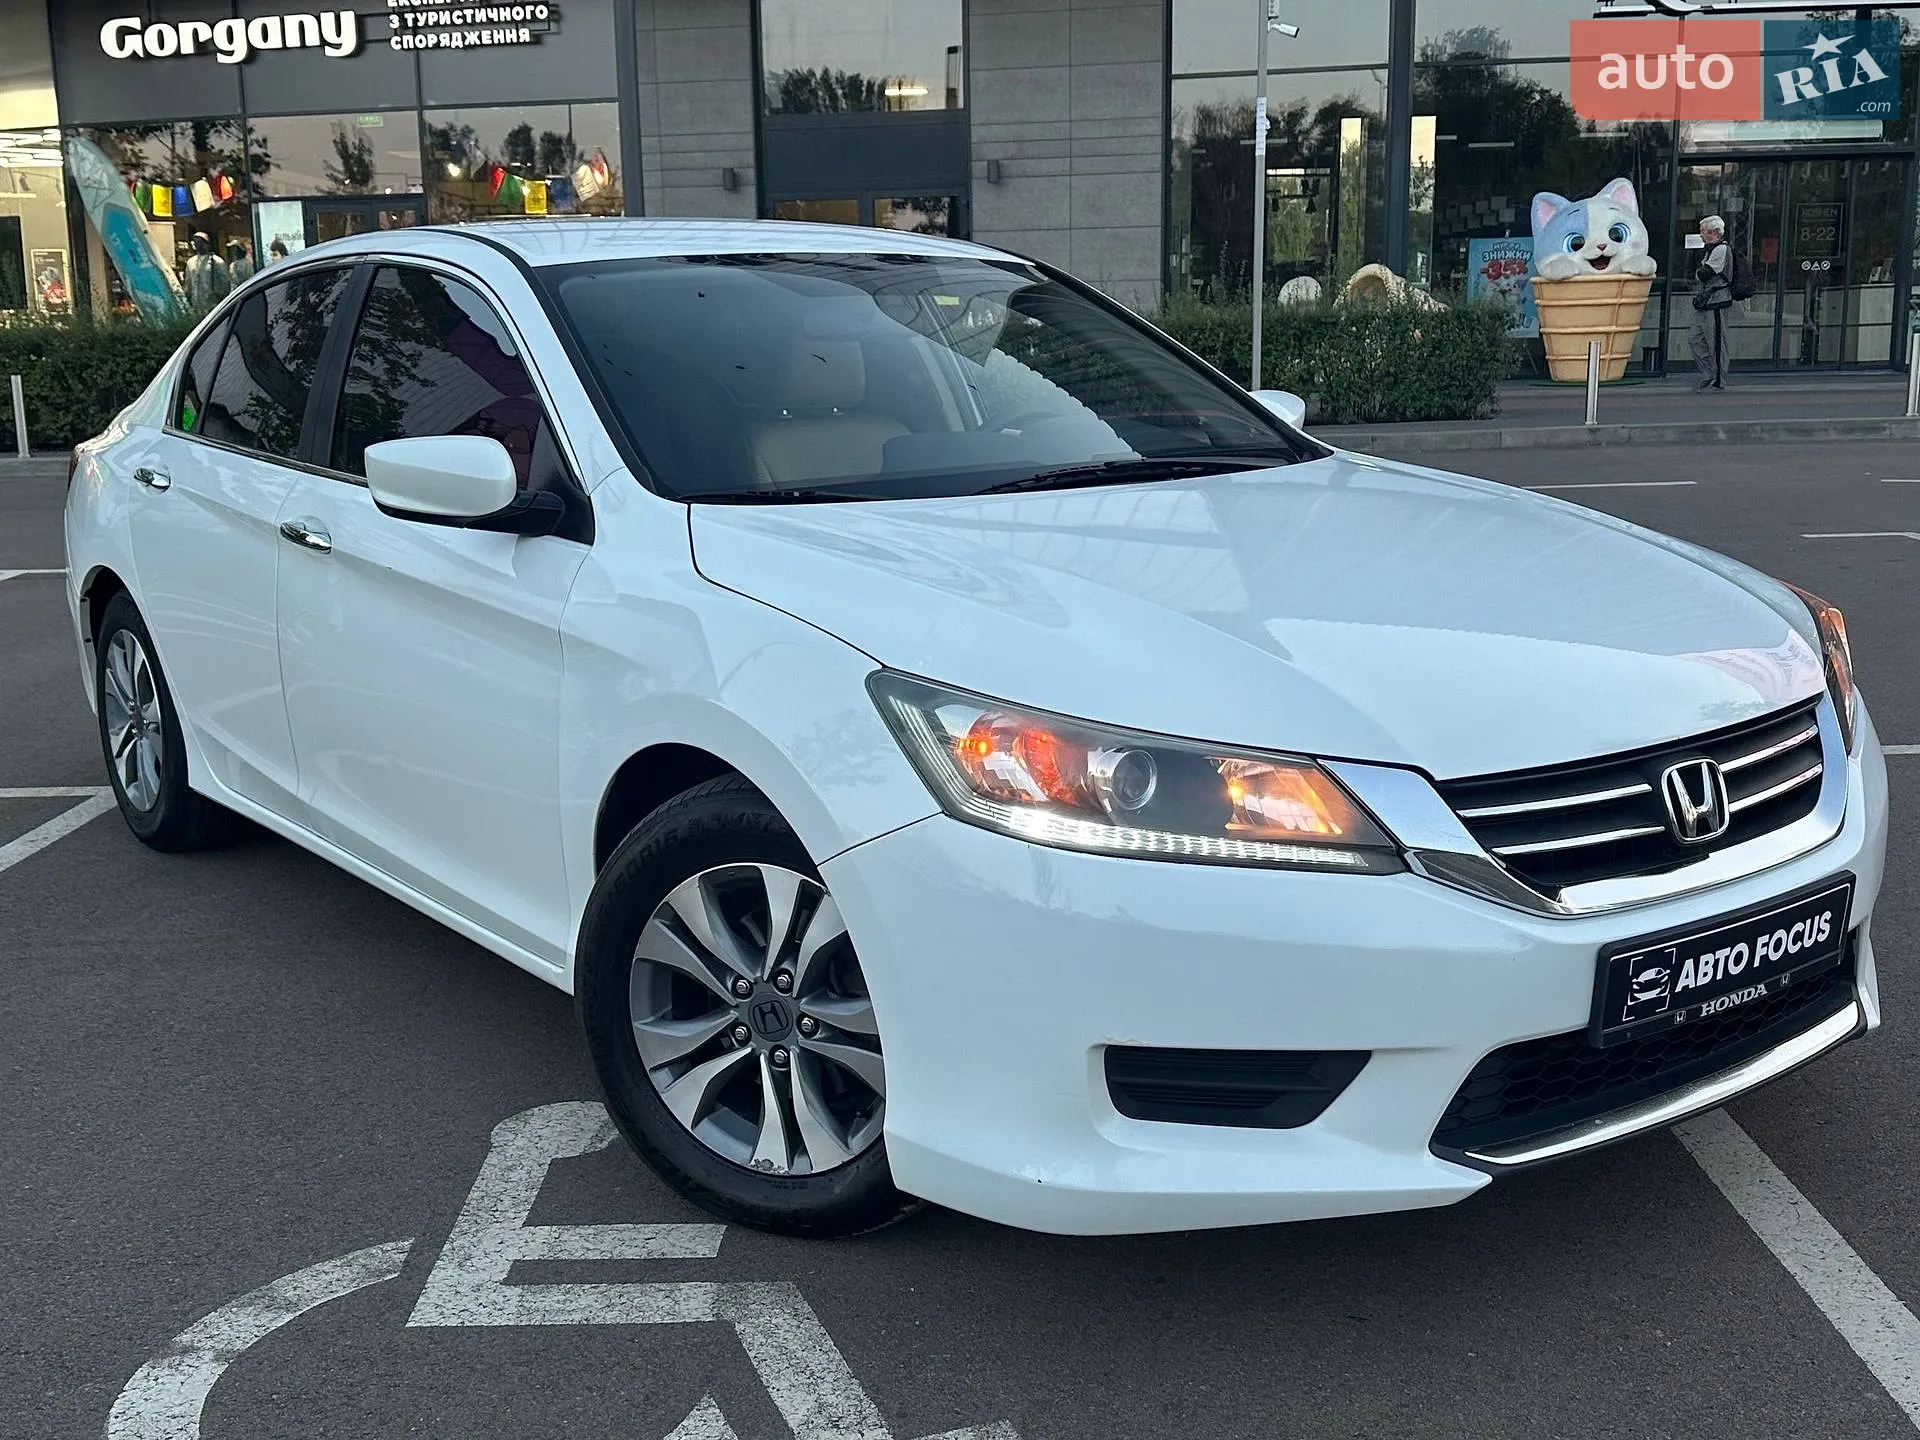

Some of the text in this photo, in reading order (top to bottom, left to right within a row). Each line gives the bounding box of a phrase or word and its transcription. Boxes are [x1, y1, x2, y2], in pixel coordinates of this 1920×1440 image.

[388, 4, 549, 29] З ТУРИСТИЧНОГО
[99, 10, 357, 64] Gorgany
[390, 28, 531, 50] СПОРЯДЖЕННЯ
[1800, 226, 1836, 241] 8-22
[1482, 250, 1532, 262] ЗНИЖКИ
[1753, 911, 1832, 968] FOCUS
[1700, 983, 1768, 1017] HONDA
